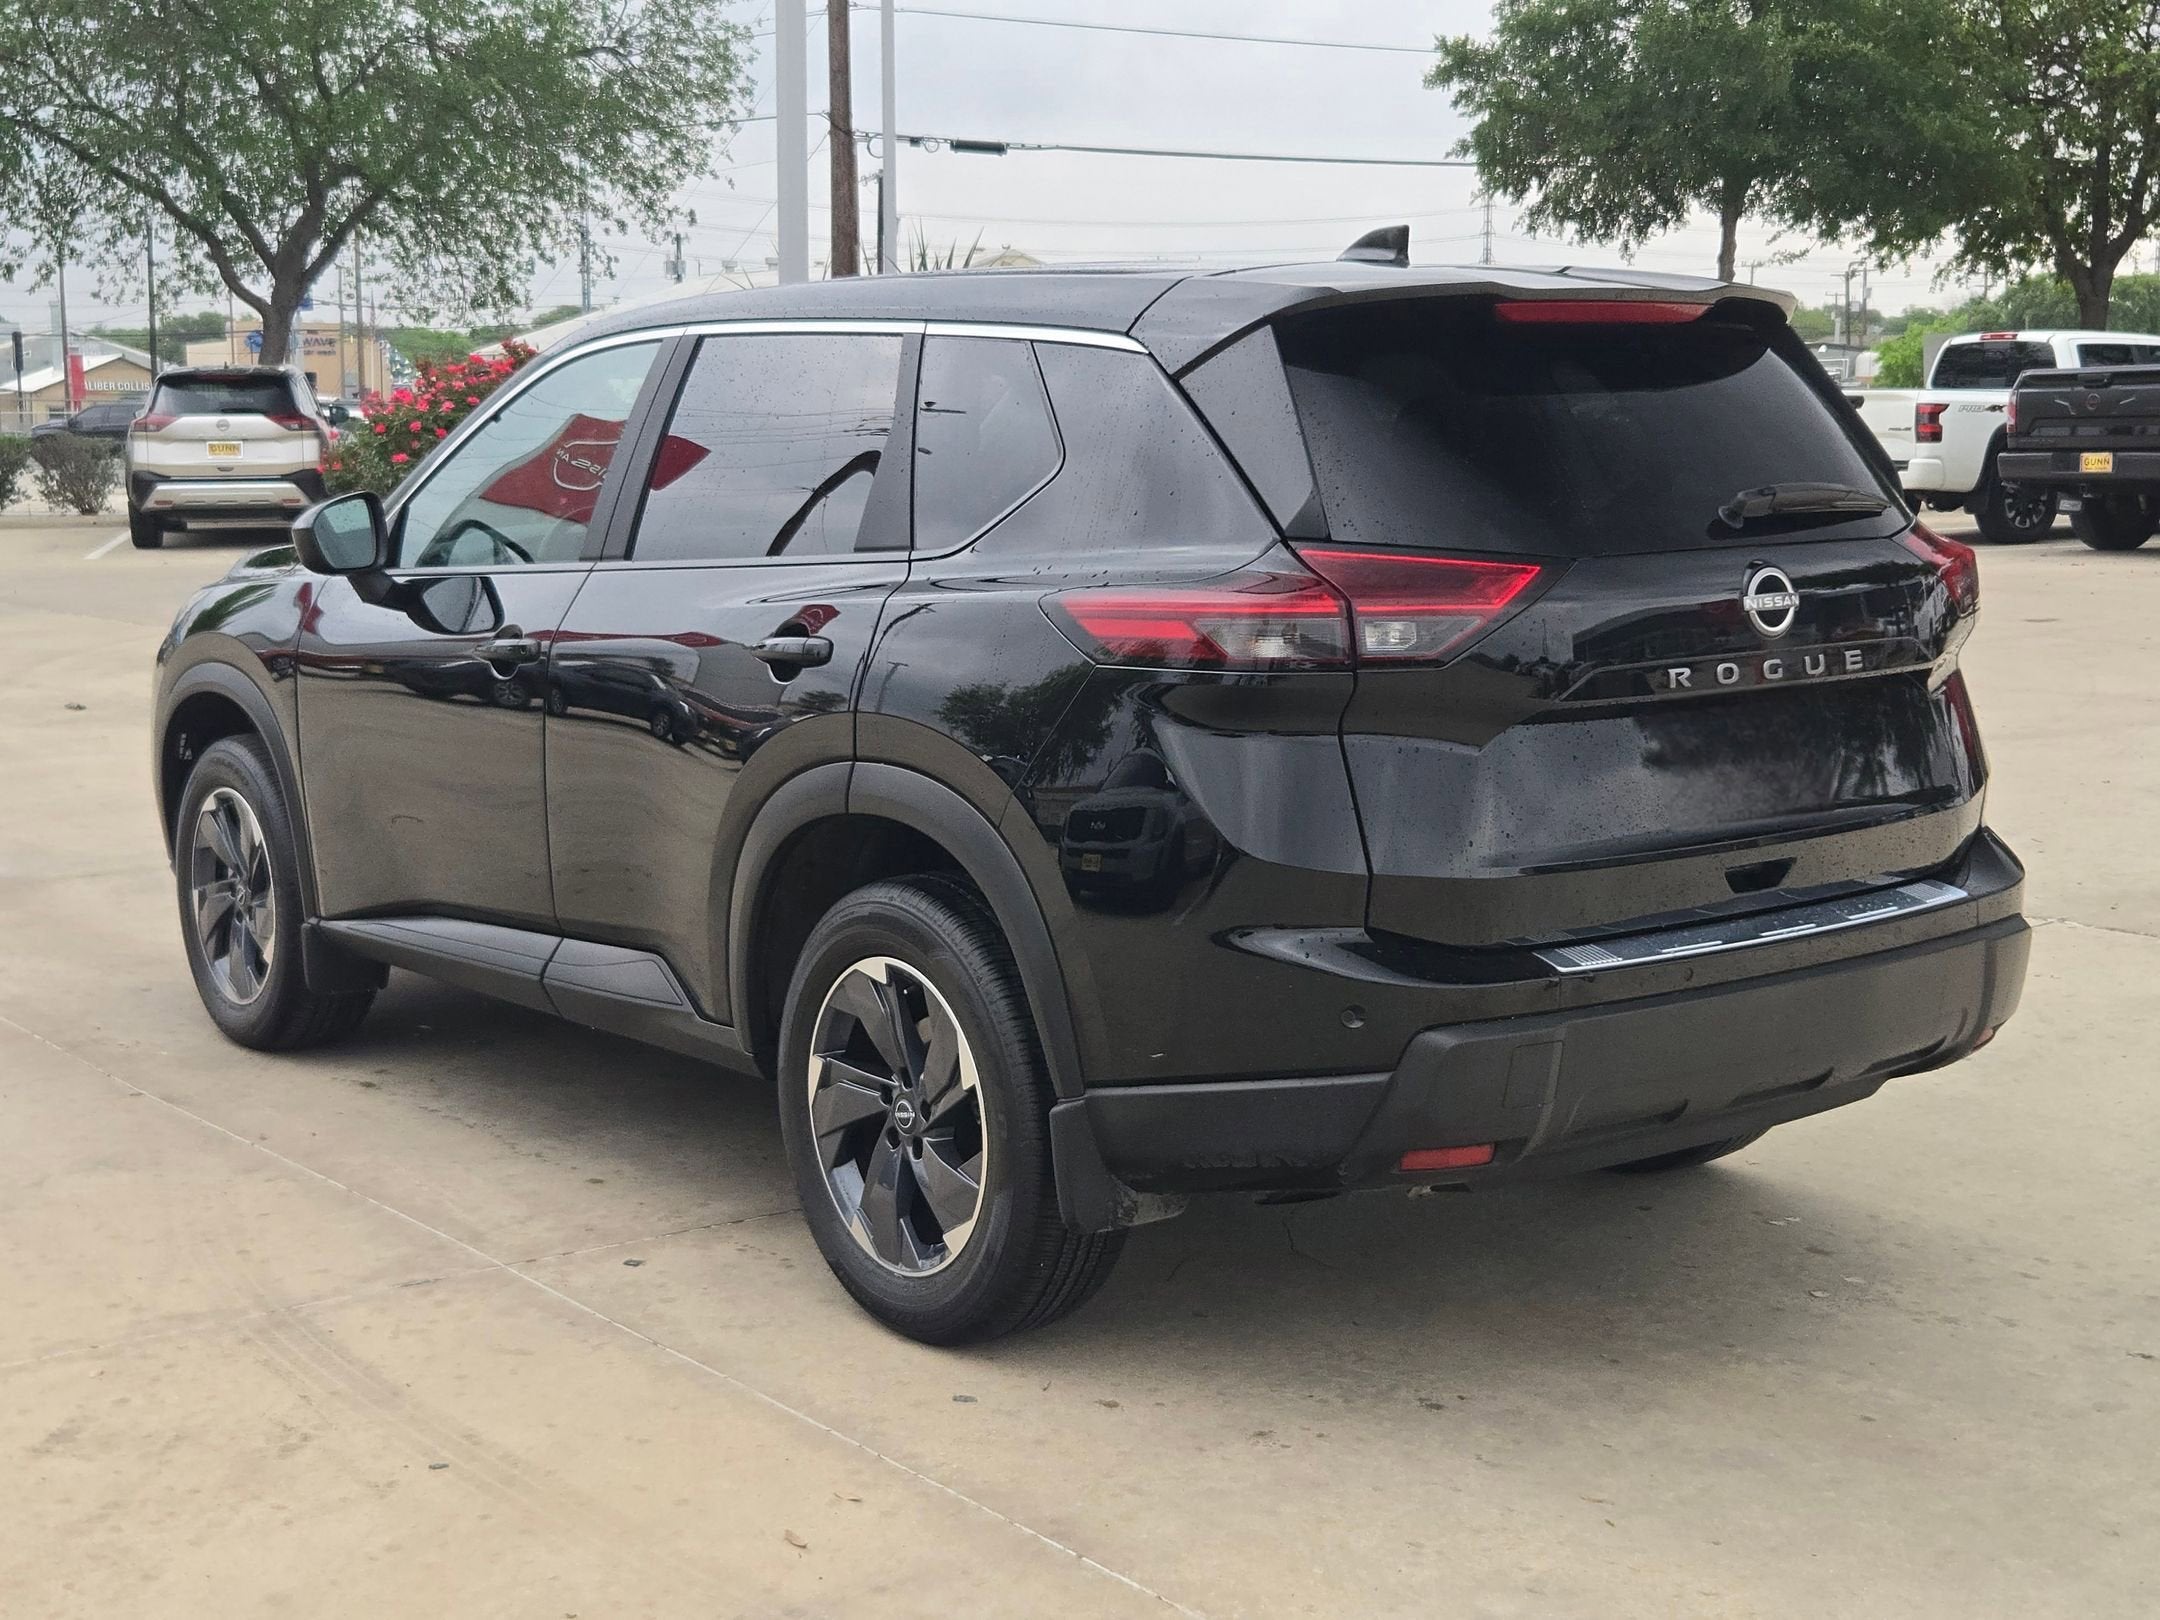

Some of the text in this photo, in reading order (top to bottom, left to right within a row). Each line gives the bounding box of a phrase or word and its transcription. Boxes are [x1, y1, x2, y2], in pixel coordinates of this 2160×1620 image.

[210, 444, 240, 452] GUNN
[2084, 457, 2110, 466] GUNN
[1745, 594, 1800, 610] NISSAN
[1668, 649, 1863, 689] ROGUE
